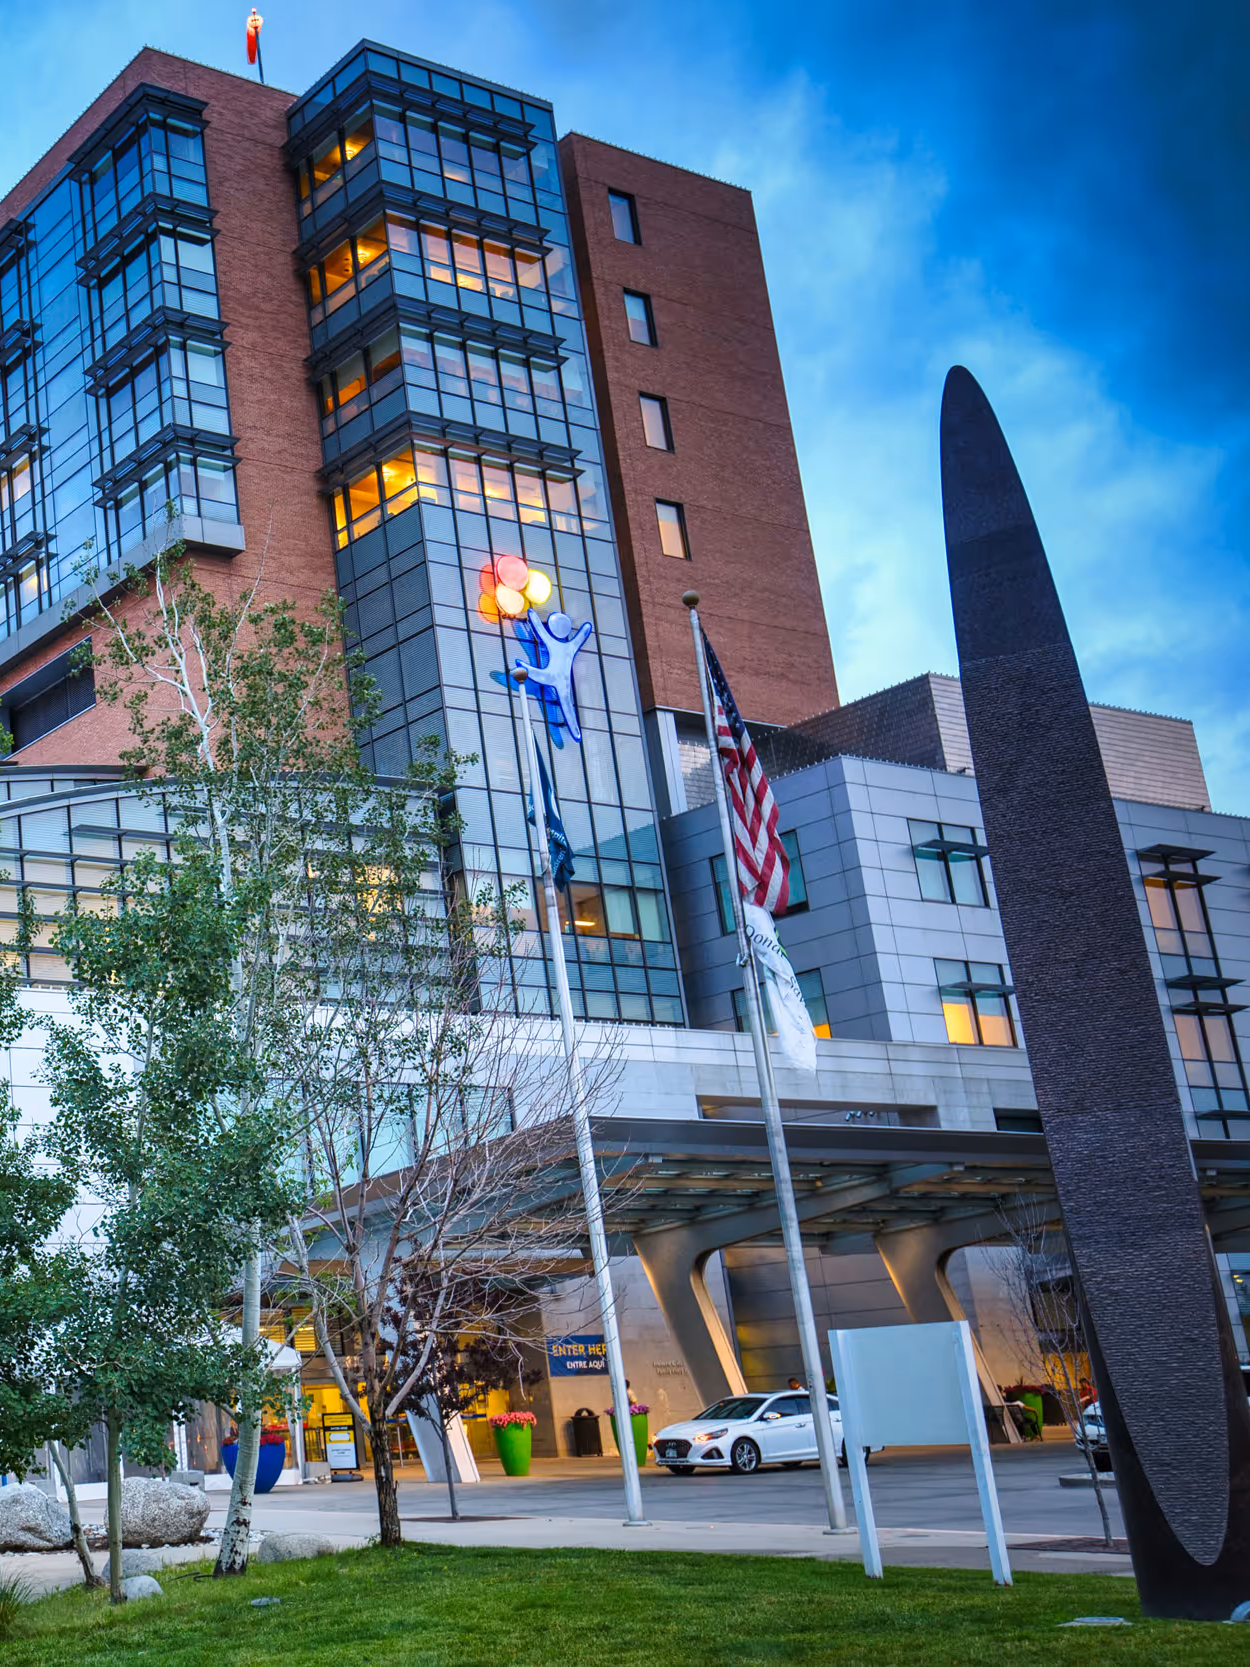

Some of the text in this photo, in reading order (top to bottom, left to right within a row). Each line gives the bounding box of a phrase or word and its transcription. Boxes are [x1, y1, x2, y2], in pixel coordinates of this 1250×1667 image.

[552, 1343, 607, 1357] ENTER HER
[566, 1360, 587, 1369] ENTRE
